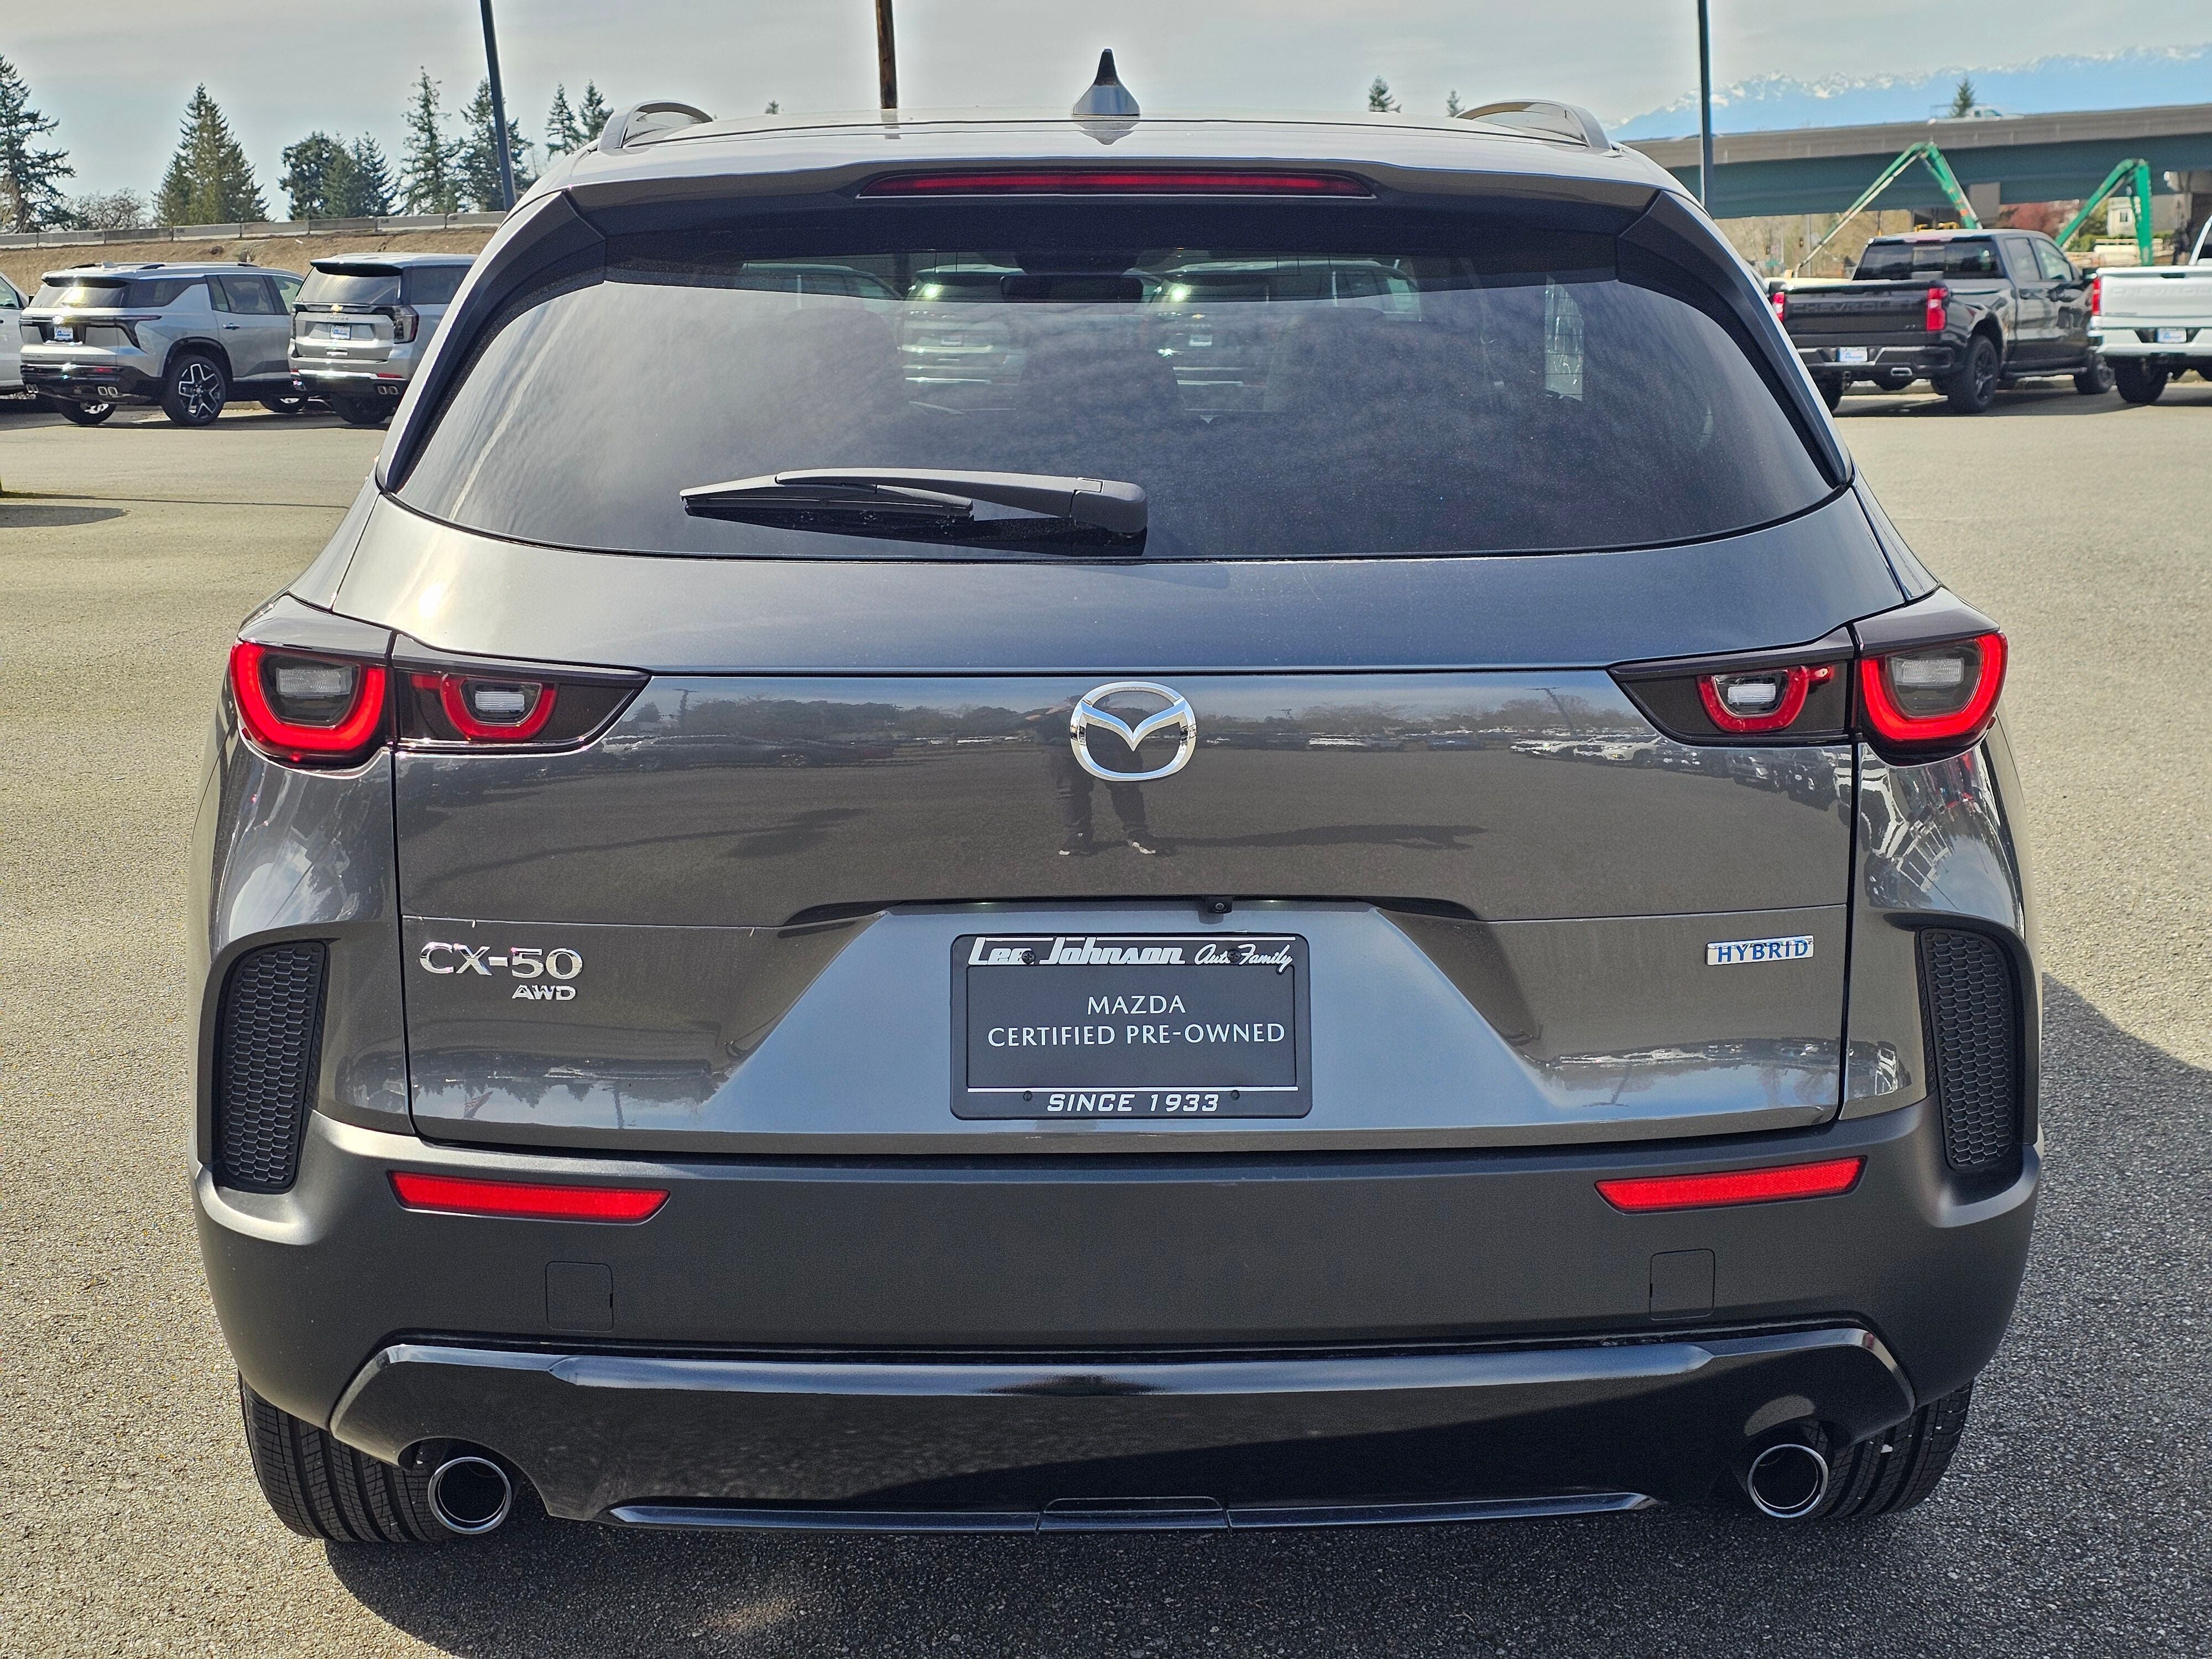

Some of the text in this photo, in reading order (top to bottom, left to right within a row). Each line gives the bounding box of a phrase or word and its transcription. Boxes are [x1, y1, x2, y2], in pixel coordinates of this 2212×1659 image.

[419, 941, 583, 979] CX-50
[1039, 937, 1186, 965] Johnson
[1237, 943, 1293, 973] Family
[1718, 939, 1808, 963] HYBRID
[512, 984, 576, 1001] AWD
[1087, 995, 1186, 1015] MAZDA
[988, 1023, 1285, 1047] CERTIFIED PRE-OWNED
[1047, 1093, 1219, 1112] SINCE 1933
